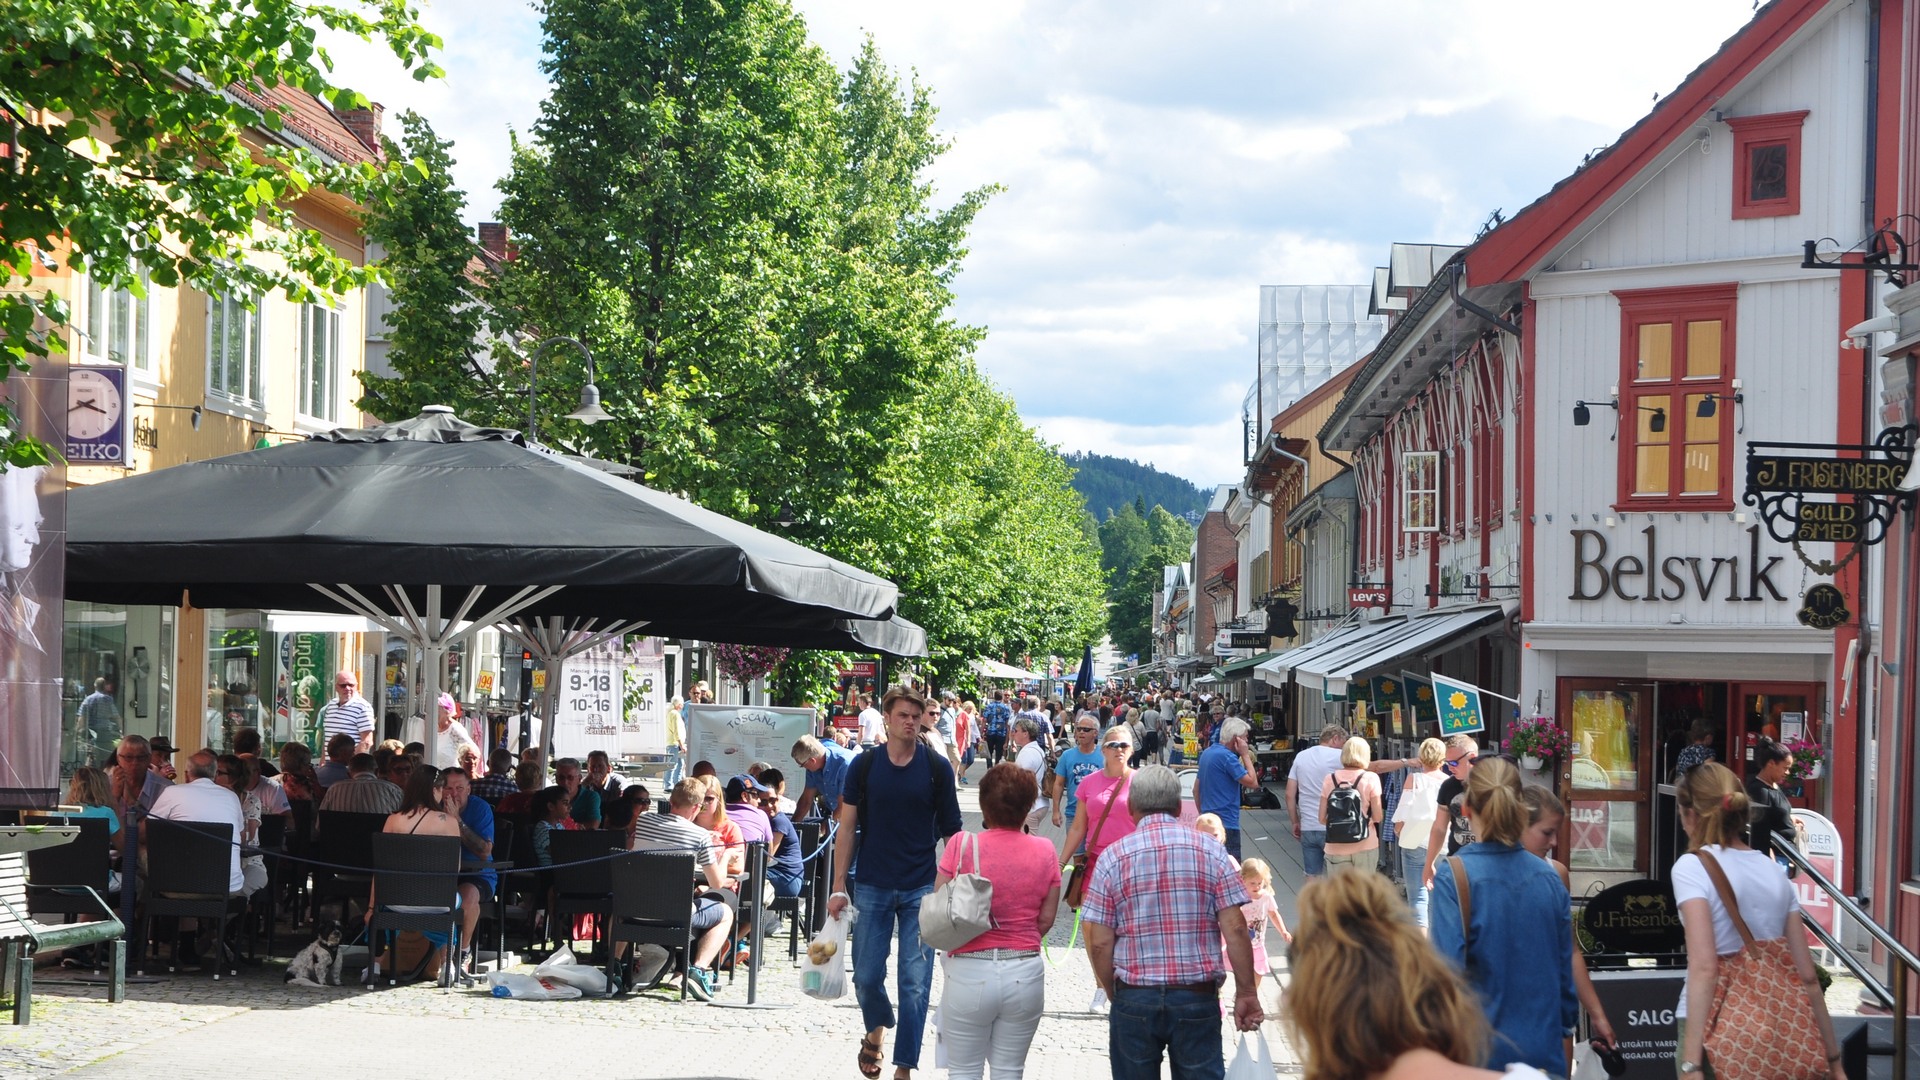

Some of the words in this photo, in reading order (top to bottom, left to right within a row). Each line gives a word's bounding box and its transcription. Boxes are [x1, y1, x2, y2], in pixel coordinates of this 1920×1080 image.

[67, 443, 120, 460] EIKO
[1757, 461, 1785, 486] J.
[1788, 461, 1904, 489] FRISENBERG
[1800, 504, 1855, 521] GULD
[1798, 523, 1857, 540] SMED
[1233, 637, 1260, 645] lunula
[296, 633, 316, 743] undesøkels
[570, 675, 610, 691] 9-18
[570, 699, 610, 711] 10-16
[727, 713, 776, 730] TOSCANA
[1446, 716, 1478, 729] SALG
[1791, 882, 1829, 907] ALE
[1628, 1009, 1674, 1026] SALG
[1621, 1040, 1652, 1049] UTGÅTTE
[1654, 1040, 1678, 1048] VARER
